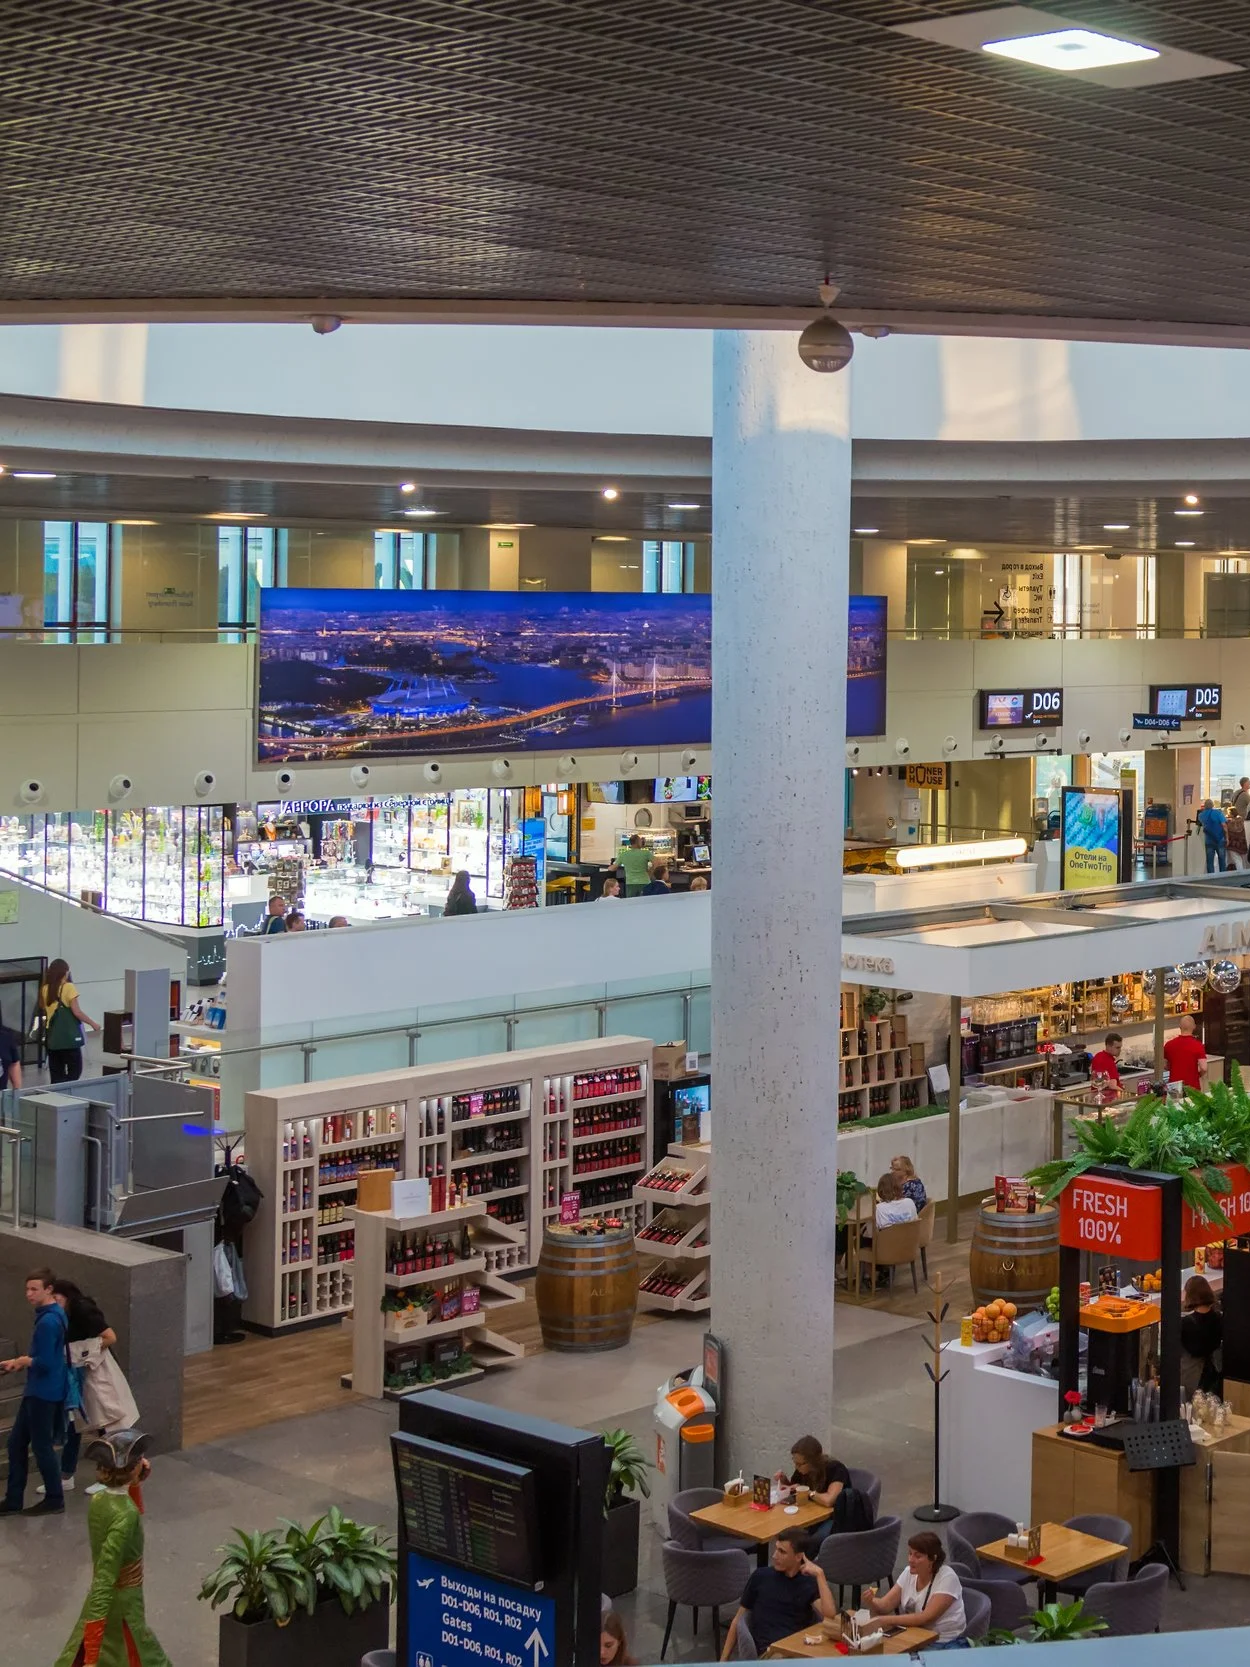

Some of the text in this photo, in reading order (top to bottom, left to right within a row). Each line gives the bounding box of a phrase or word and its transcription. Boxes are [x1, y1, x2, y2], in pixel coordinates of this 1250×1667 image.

[1033, 692, 1060, 710] D06
[1195, 688, 1219, 705] D05
[1069, 860, 1112, 872] OneTwoTrip
[1074, 851, 1097, 861] Отели
[1073, 1188, 1127, 1218] FRESH
[1192, 1196, 1236, 1228] FRSH
[1078, 1217, 1121, 1244] 100%
[441, 1575, 541, 1623] Выходы на посадку
[441, 1593, 522, 1630] D01-D06, R01, R02
[442, 1613, 472, 1633] Gates
[441, 1630, 522, 1667] D01-D06, R01, R02
